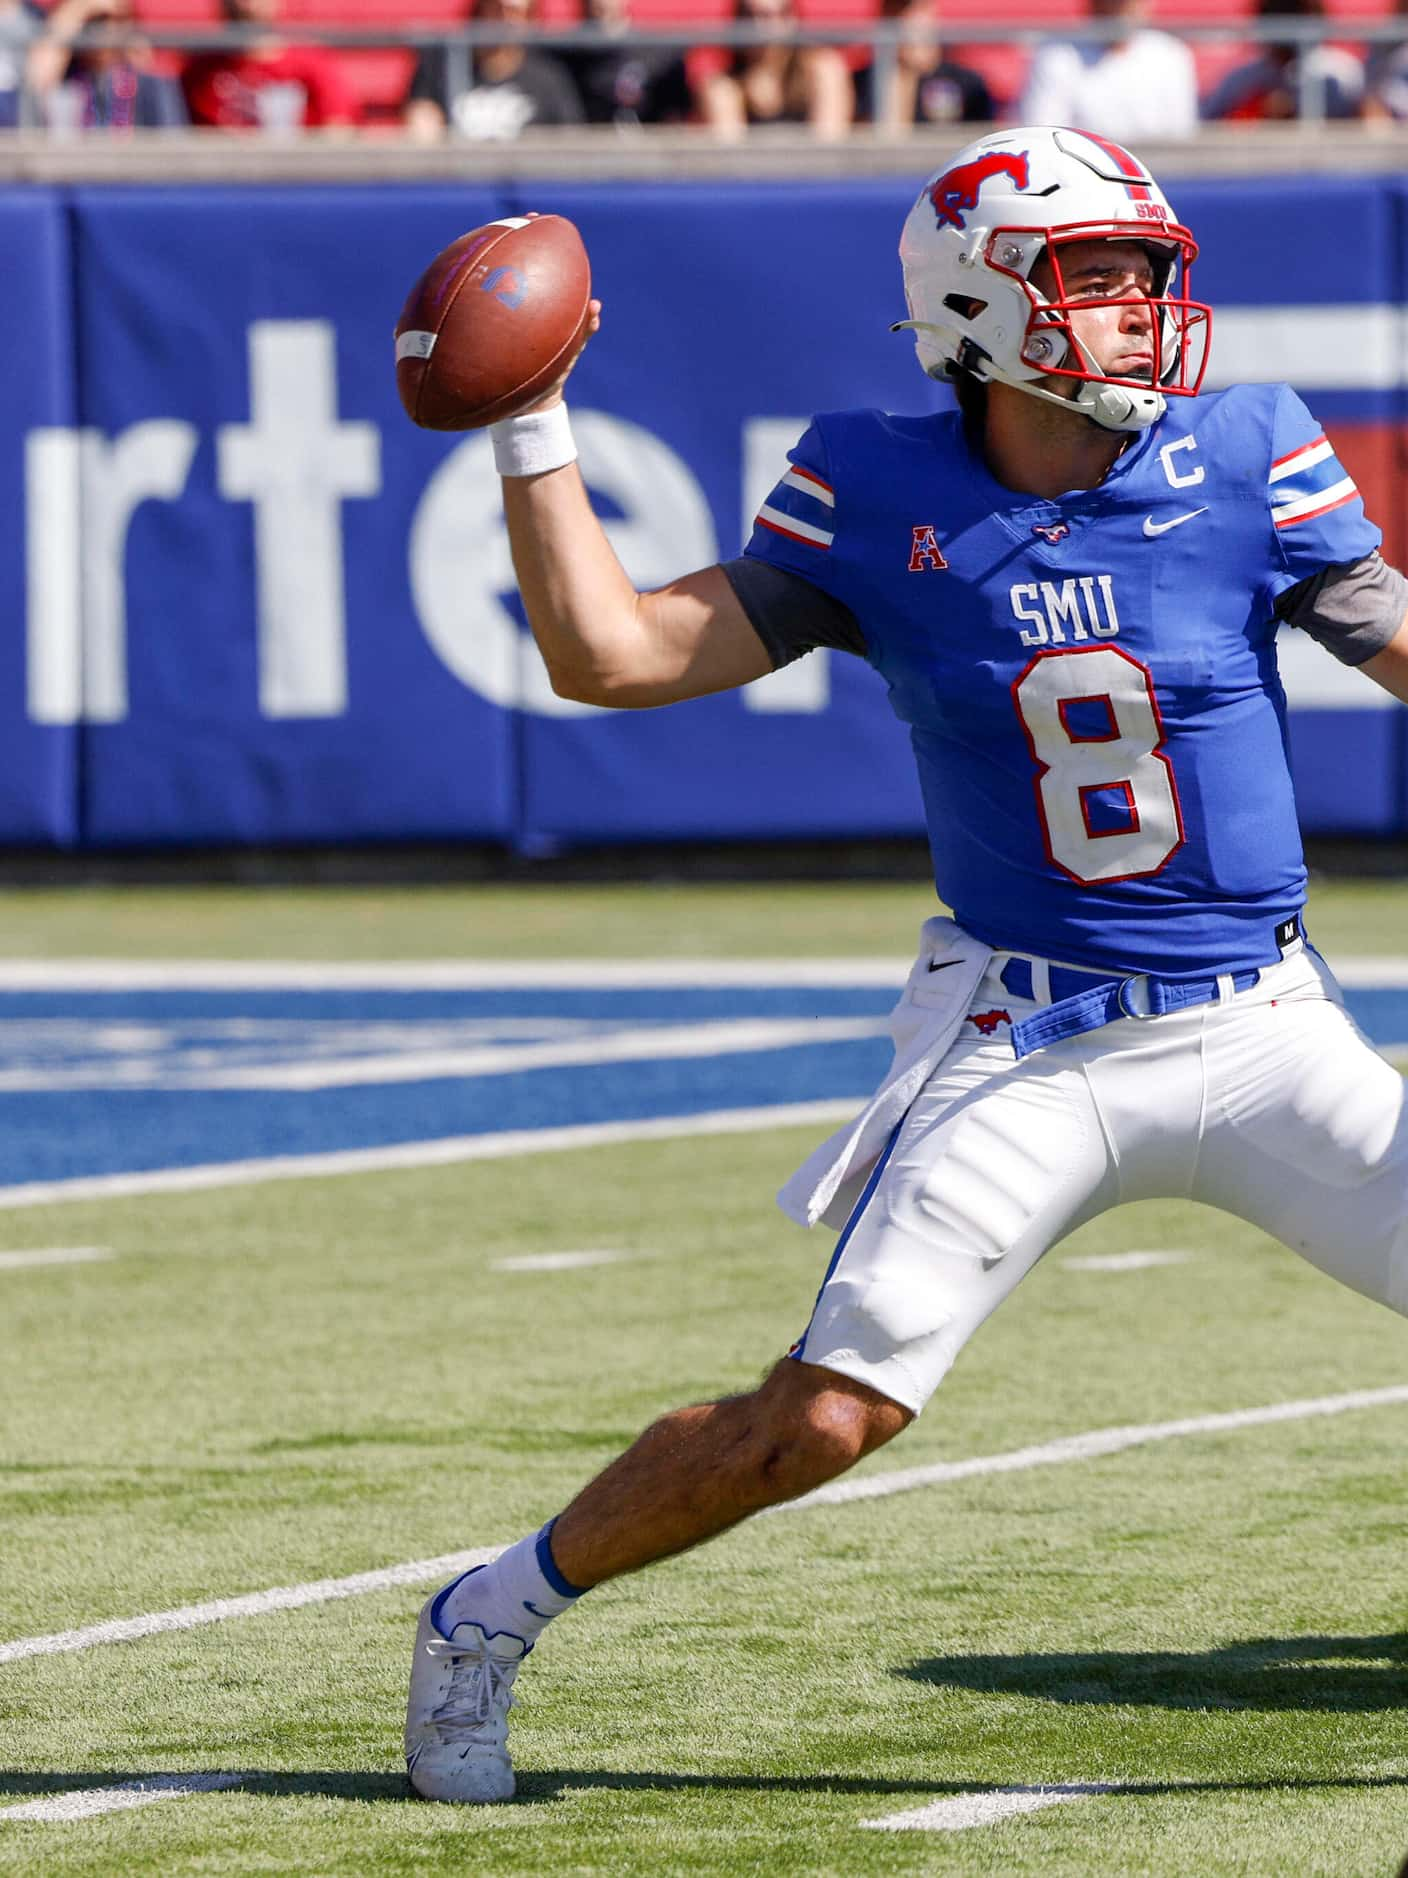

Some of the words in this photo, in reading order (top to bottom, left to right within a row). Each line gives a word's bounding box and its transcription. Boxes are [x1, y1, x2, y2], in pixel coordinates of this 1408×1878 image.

[1134, 203, 1168, 220] SMU
[1158, 434, 1206, 489] C
[908, 525, 948, 572] A
[1010, 575, 1120, 646] SMU
[1011, 643, 1187, 887] 8
